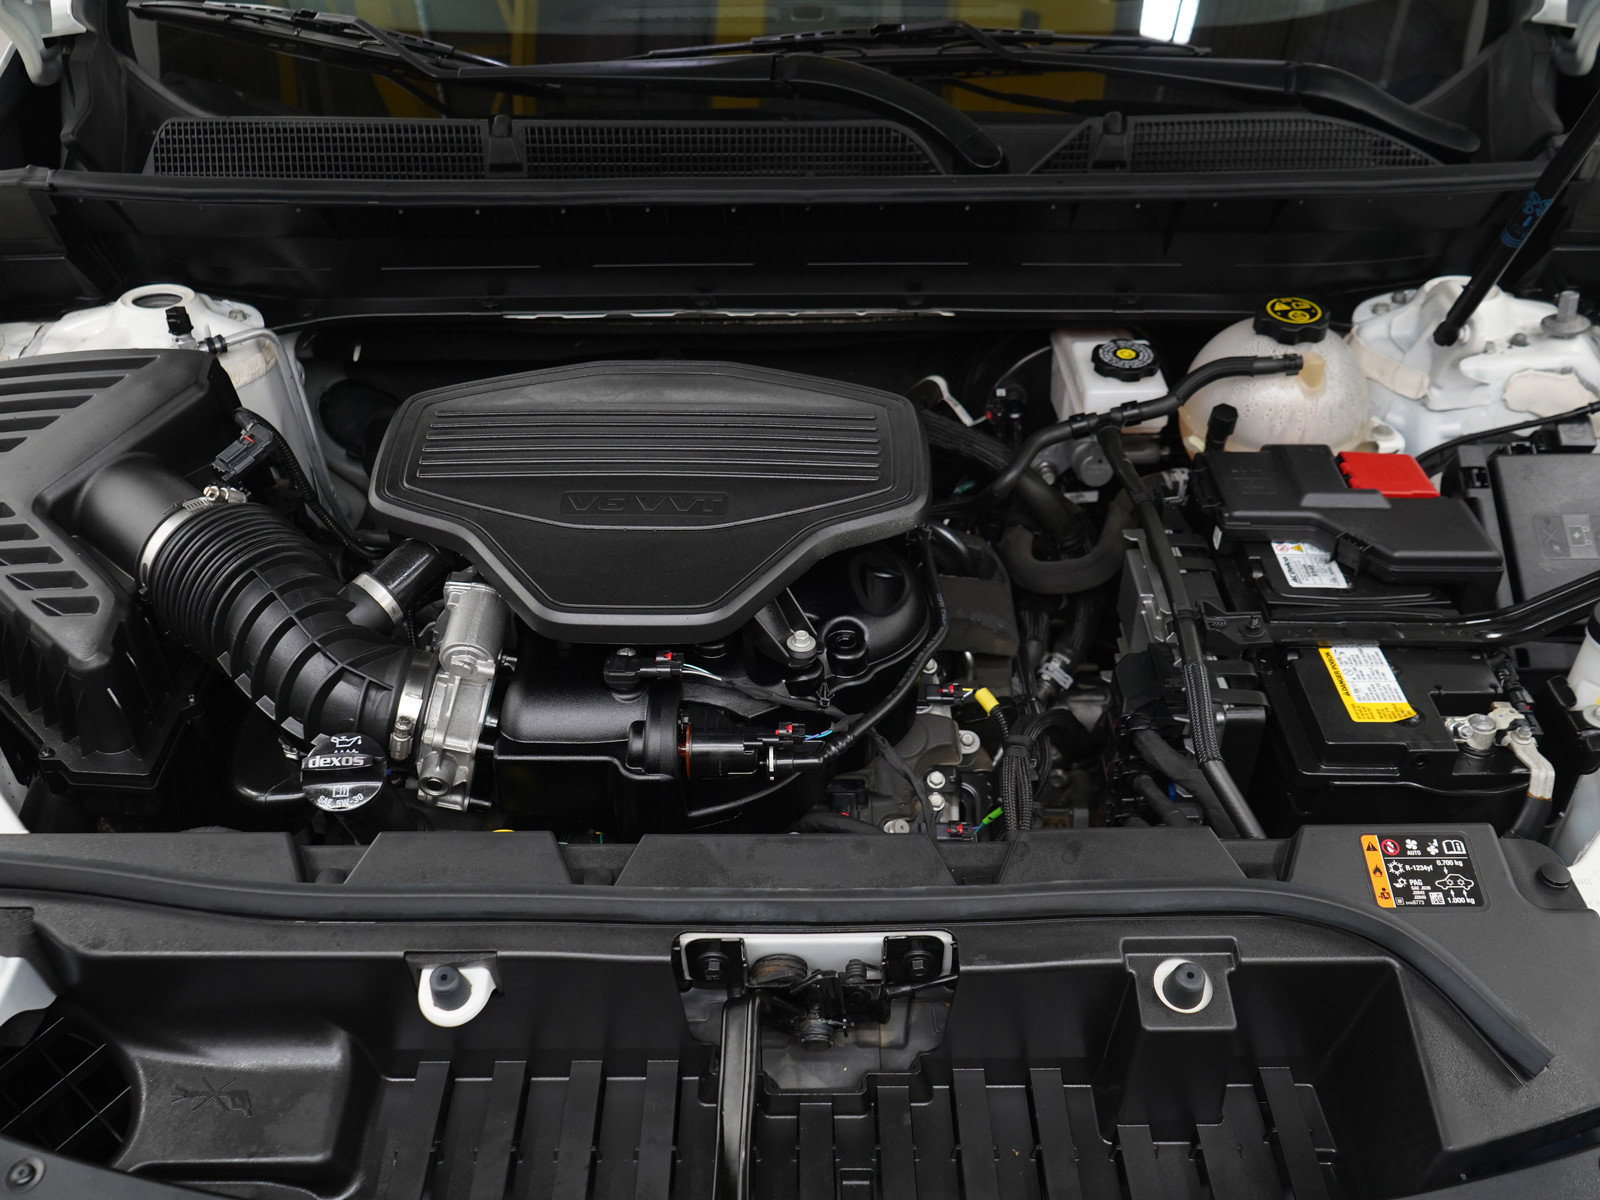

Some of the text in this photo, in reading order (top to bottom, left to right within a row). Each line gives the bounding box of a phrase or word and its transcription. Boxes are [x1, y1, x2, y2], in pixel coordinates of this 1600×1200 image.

[568, 495, 723, 513] V6 VVT
[1323, 651, 1348, 691] DANGER POISON
[308, 755, 367, 769] dexos
[317, 793, 364, 808] SAE 5W-30
[1405, 864, 1433, 873] R-1234yf
[1454, 859, 1464, 867] kg
[1466, 897, 1476, 905] kg
